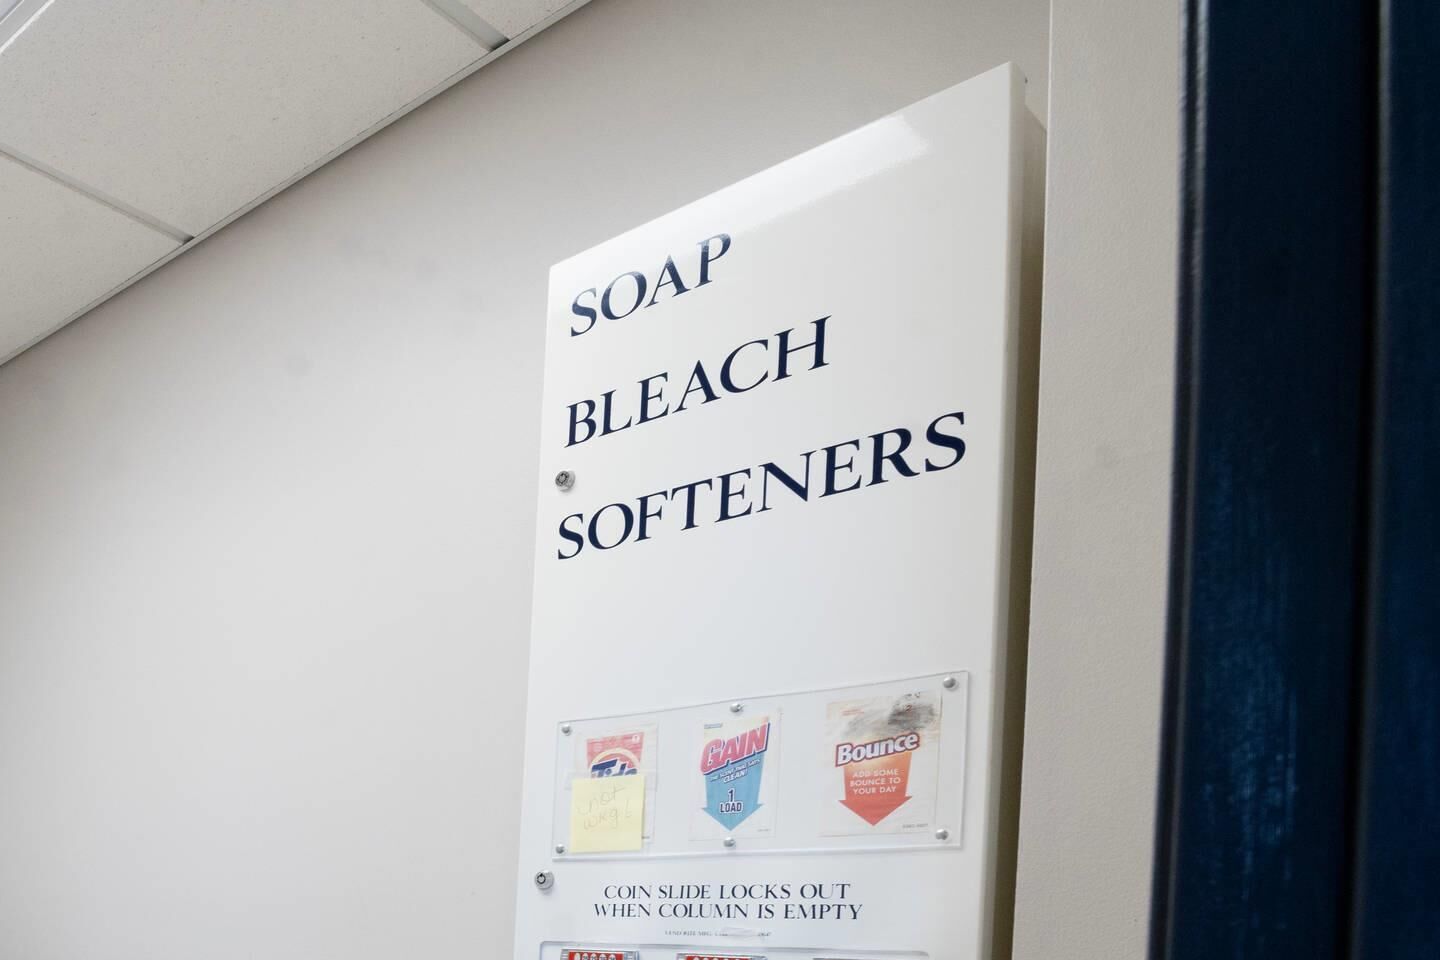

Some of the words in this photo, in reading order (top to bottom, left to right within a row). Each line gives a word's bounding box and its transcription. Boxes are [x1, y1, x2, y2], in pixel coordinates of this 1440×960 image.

[570, 233, 732, 337] SOAP
[564, 315, 832, 448] BLEACH
[557, 411, 967, 560] SOFTENERS
[700, 723, 769, 774] GAIN
[836, 732, 919, 767] Bounce
[873, 768, 899, 776] SOME
[850, 778, 886, 787] BOUNCE
[853, 787, 876, 795] YOUR
[728, 789, 734, 802] 1
[720, 802, 742, 813] LOAD
[604, 884, 652, 900] COIN
[658, 884, 711, 900] SLIDE
[719, 884, 791, 900] LOCKS
[799, 883, 851, 900] OUT
[594, 903, 652, 918] WHEN
[658, 903, 749, 919] COLUMN
[757, 903, 775, 920] IS
[784, 903, 863, 920] EMPTY
